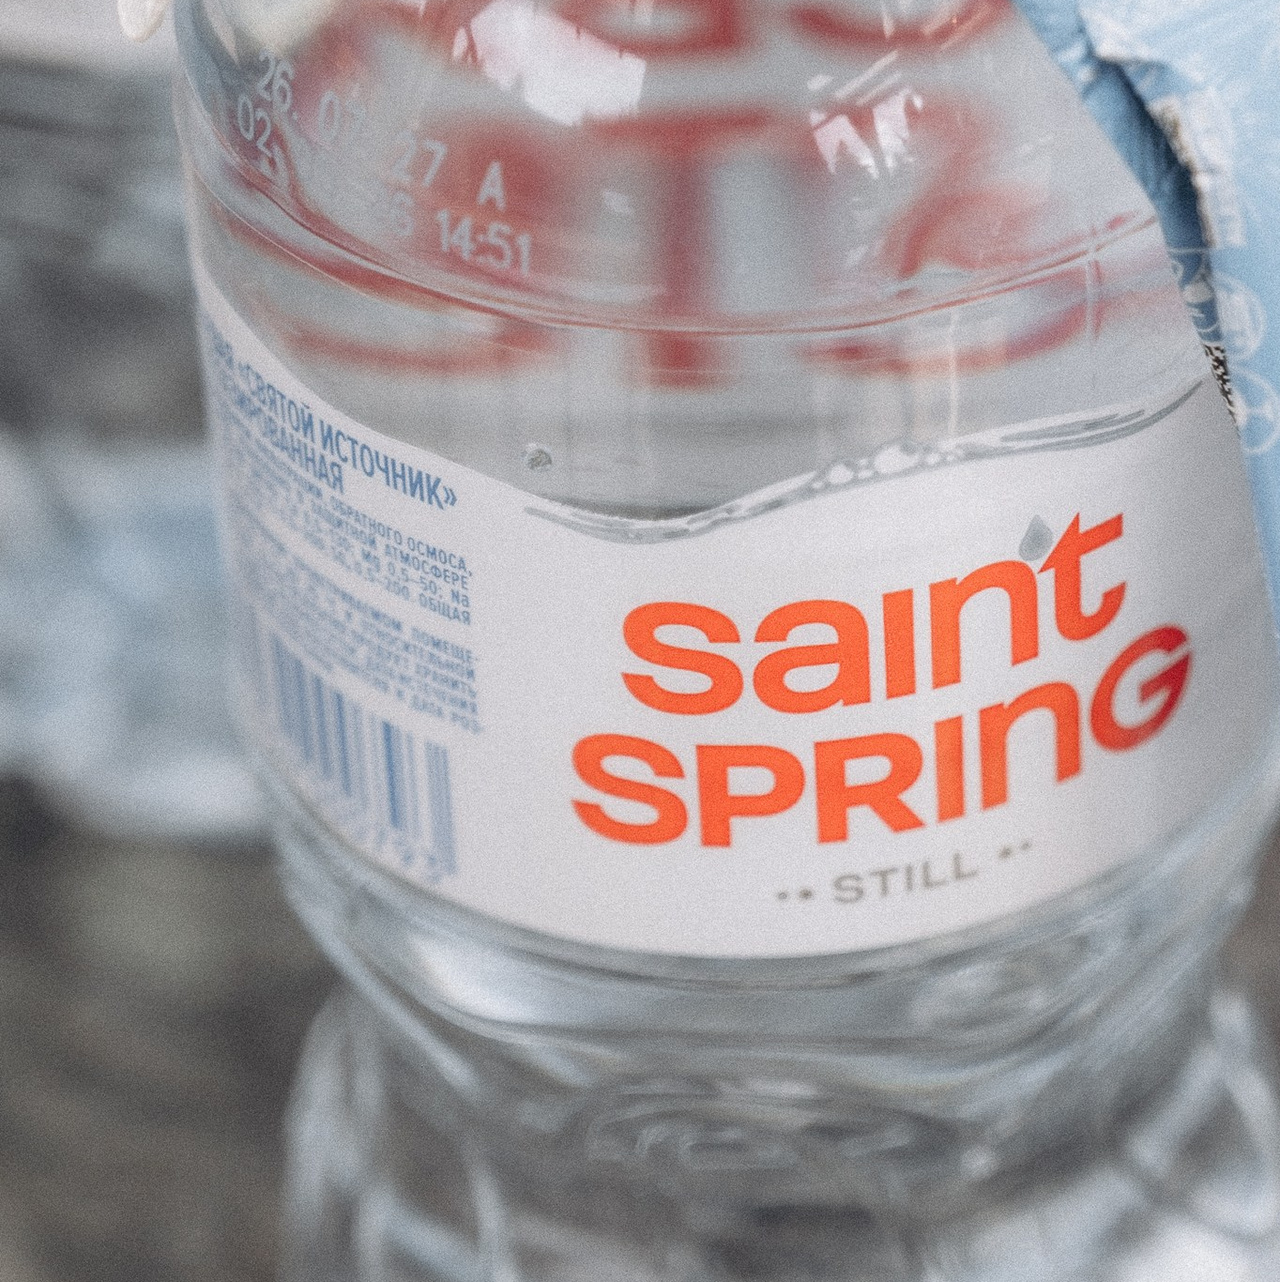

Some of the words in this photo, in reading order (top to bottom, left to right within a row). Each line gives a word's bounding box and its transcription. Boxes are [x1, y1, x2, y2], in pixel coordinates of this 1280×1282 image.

[435, 208, 532, 278] 14:51
[318, 419, 458, 511] ИСТОЧНИК»
[407, 536, 473, 578] ОСМОСА,
[832, 851, 980, 905] STILL
